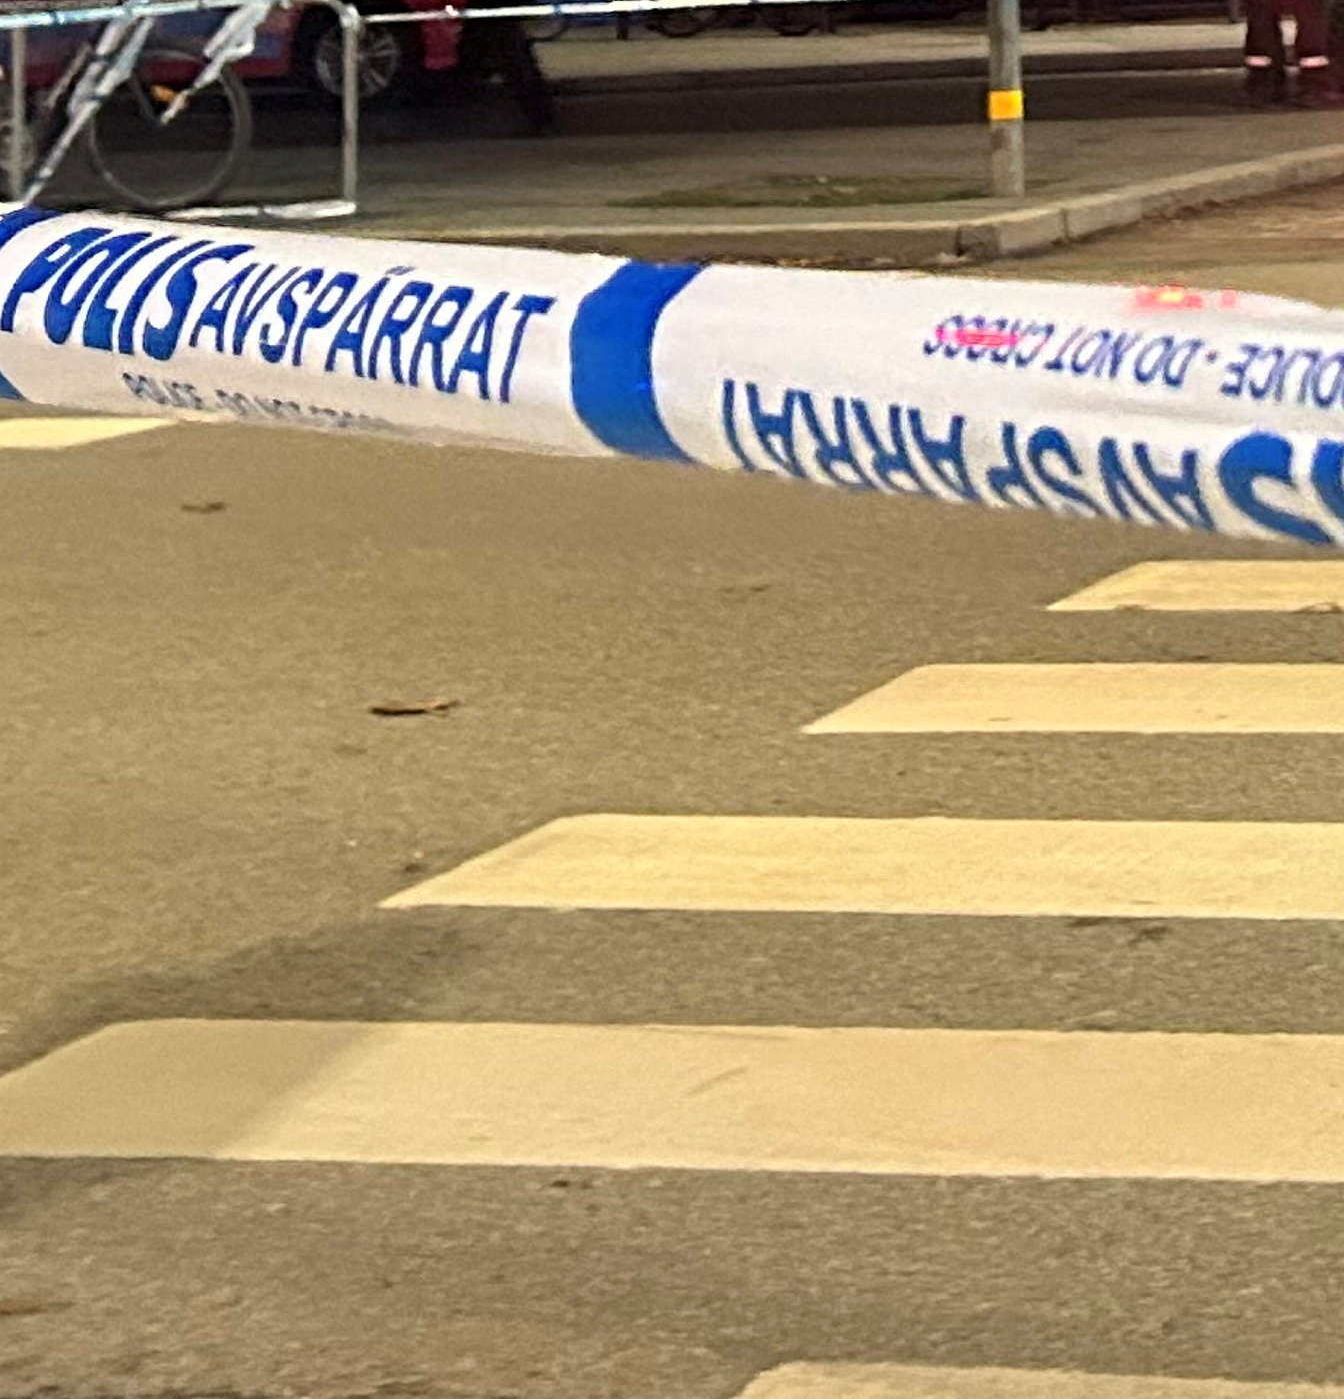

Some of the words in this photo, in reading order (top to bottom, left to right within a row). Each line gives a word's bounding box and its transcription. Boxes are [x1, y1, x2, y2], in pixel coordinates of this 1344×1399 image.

[1, 227, 256, 361] POLIS
[190, 262, 557, 402] AVSPÄRRAT
[1045, 324, 1128, 380] NOT
[1134, 334, 1203, 388] DO
